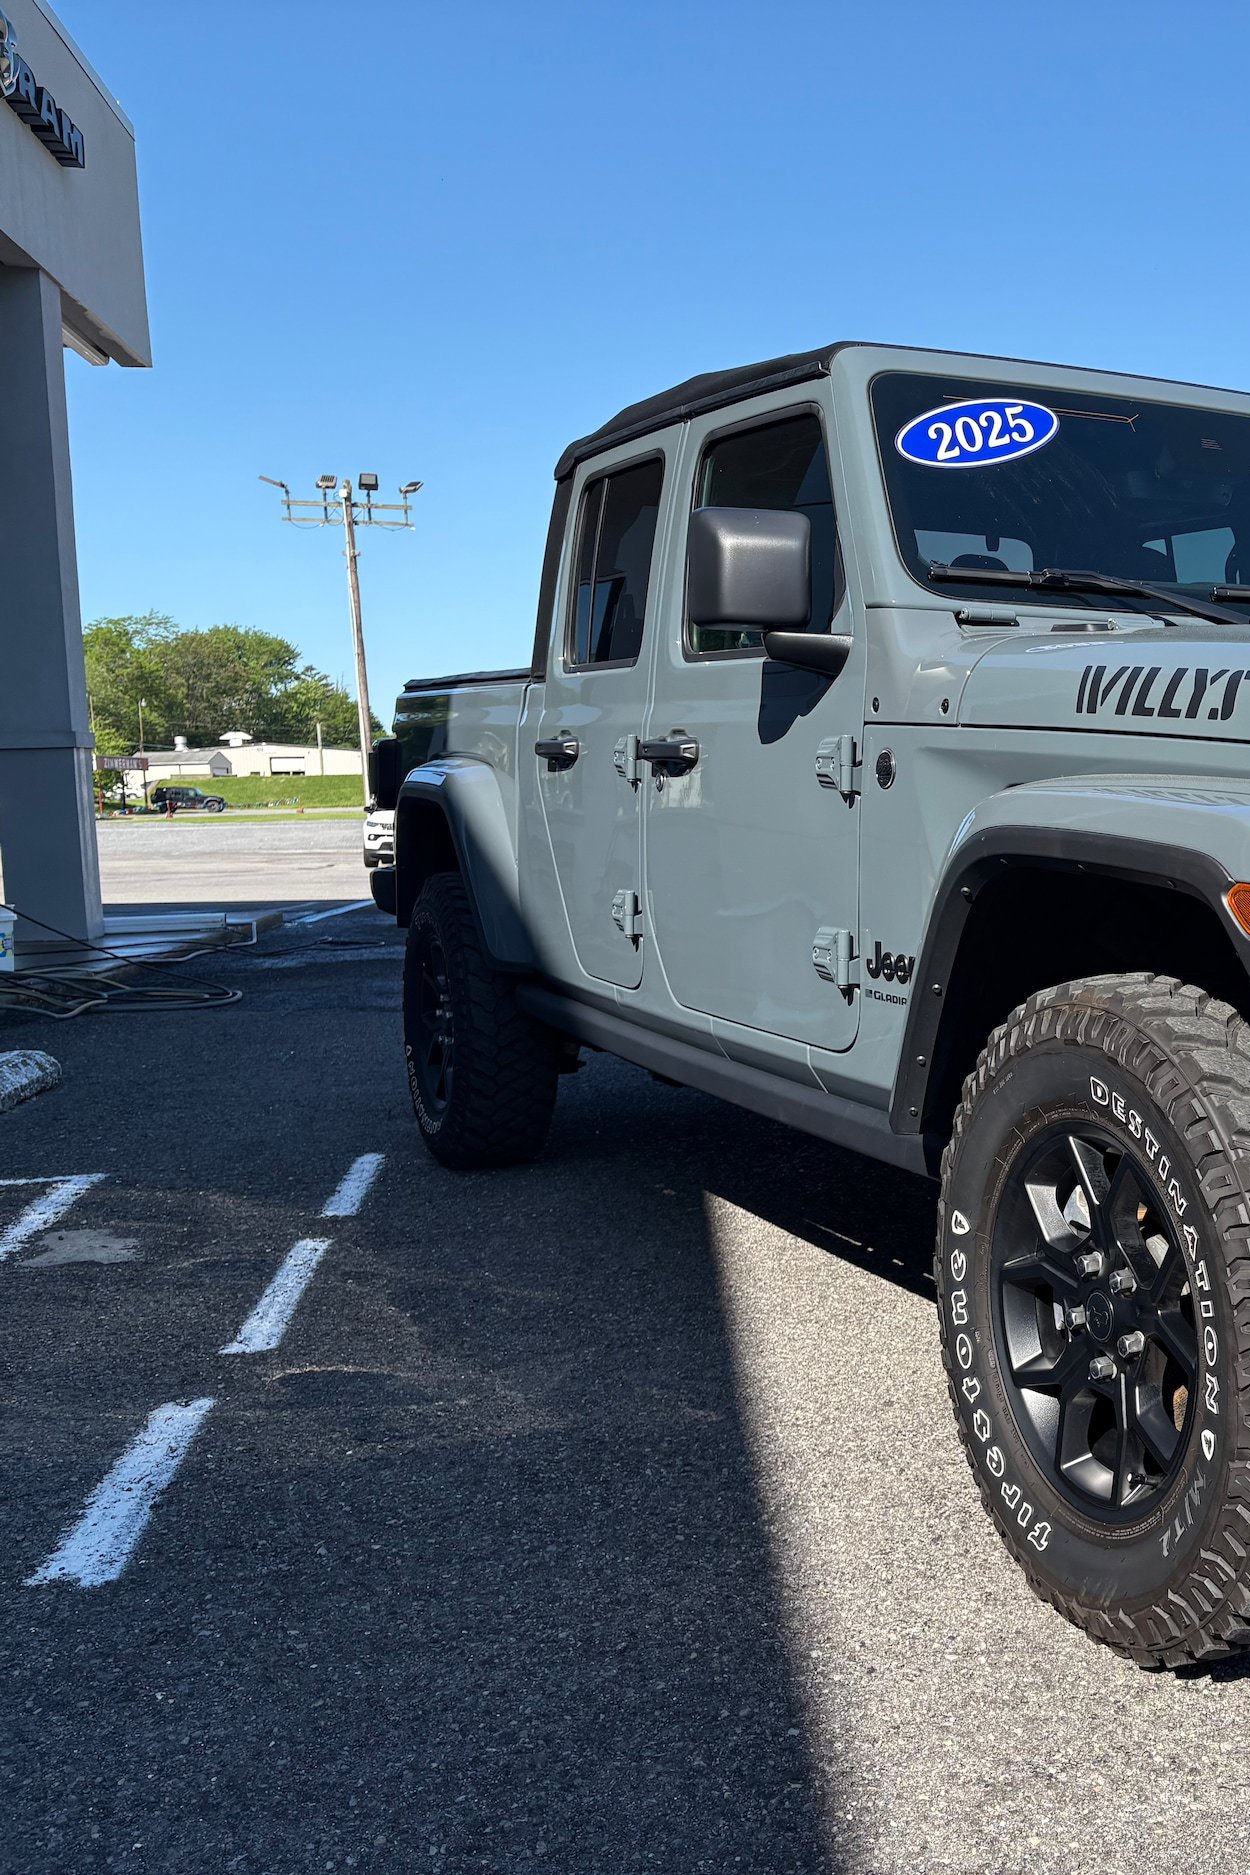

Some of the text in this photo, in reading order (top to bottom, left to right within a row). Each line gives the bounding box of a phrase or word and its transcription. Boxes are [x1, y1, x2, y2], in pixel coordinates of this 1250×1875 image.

[15, 54, 85, 168] RAM
[927, 405, 1035, 461] 2025
[873, 990, 908, 1006] GLADIA
[1089, 1075, 1221, 1416] DESTINATION
[950, 1247, 1054, 1553] Firestone
